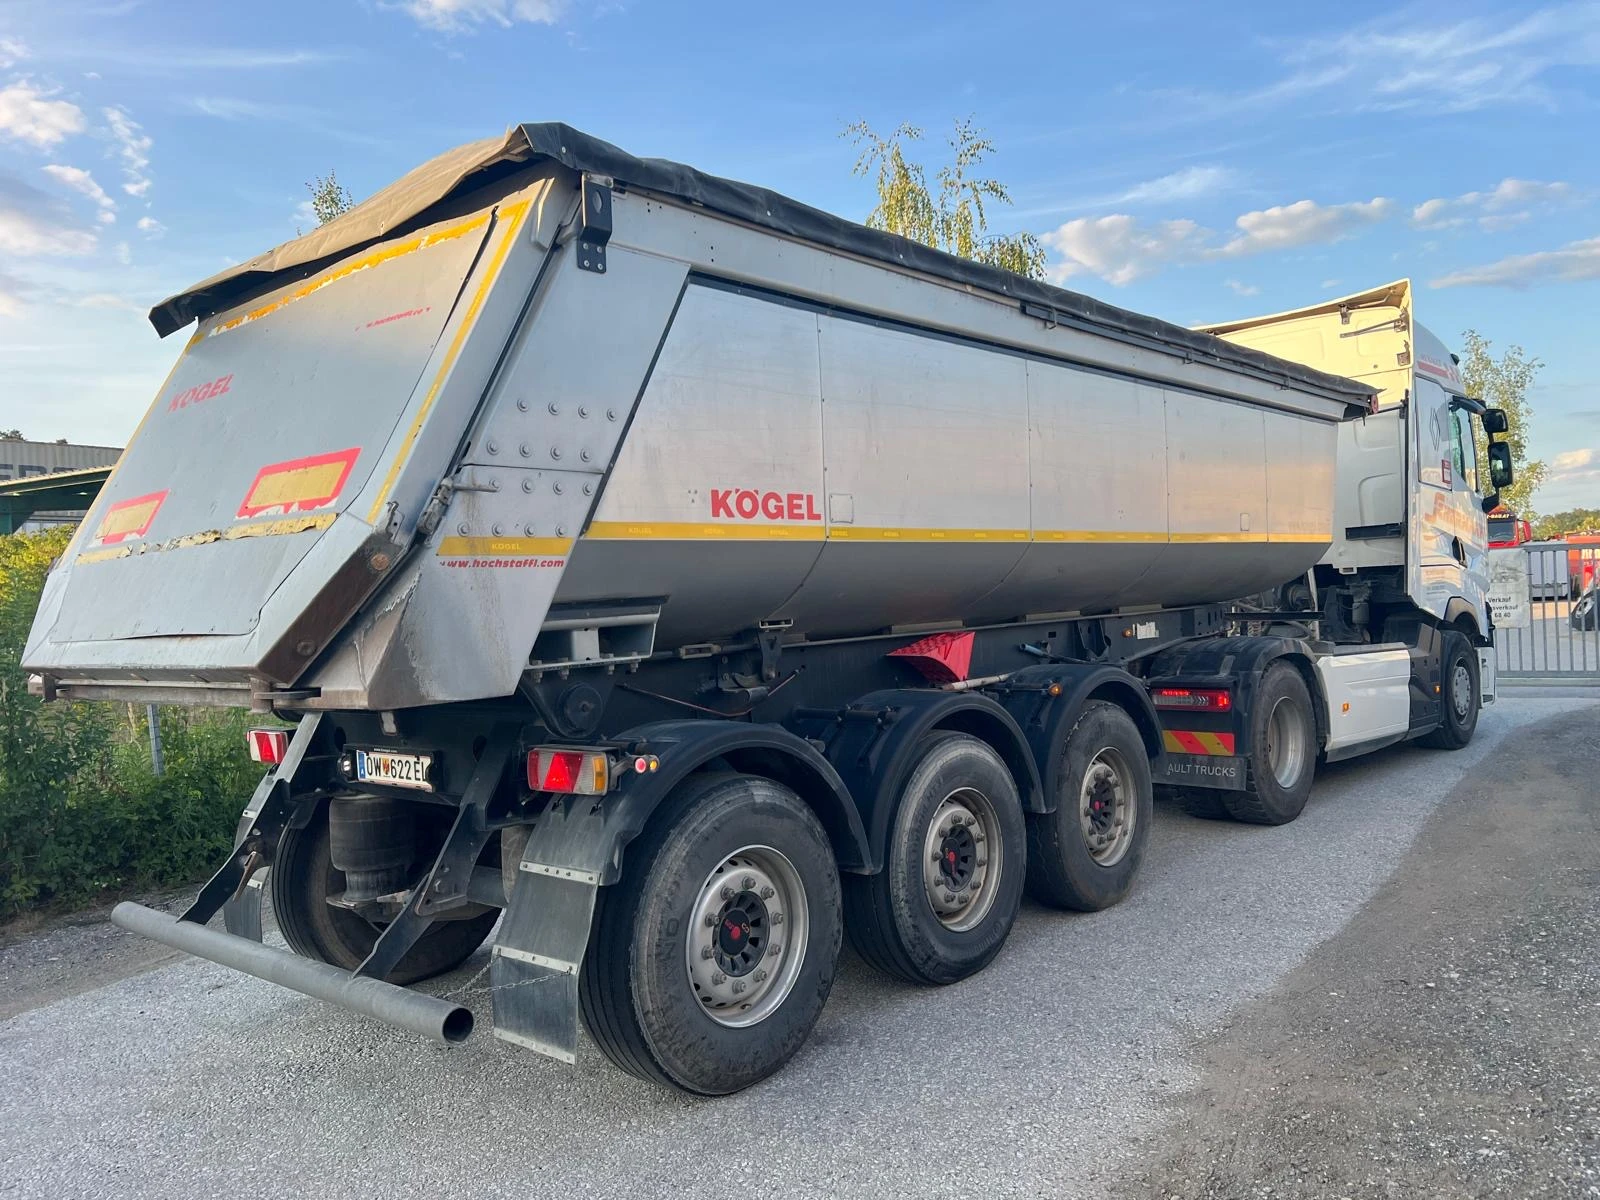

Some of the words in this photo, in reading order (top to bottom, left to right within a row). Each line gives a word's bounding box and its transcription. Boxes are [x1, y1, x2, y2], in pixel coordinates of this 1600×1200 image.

[710, 488, 822, 521] KÖGEL
[390, 759, 411, 780] 622
[1195, 765, 1236, 777] TRUCKS
